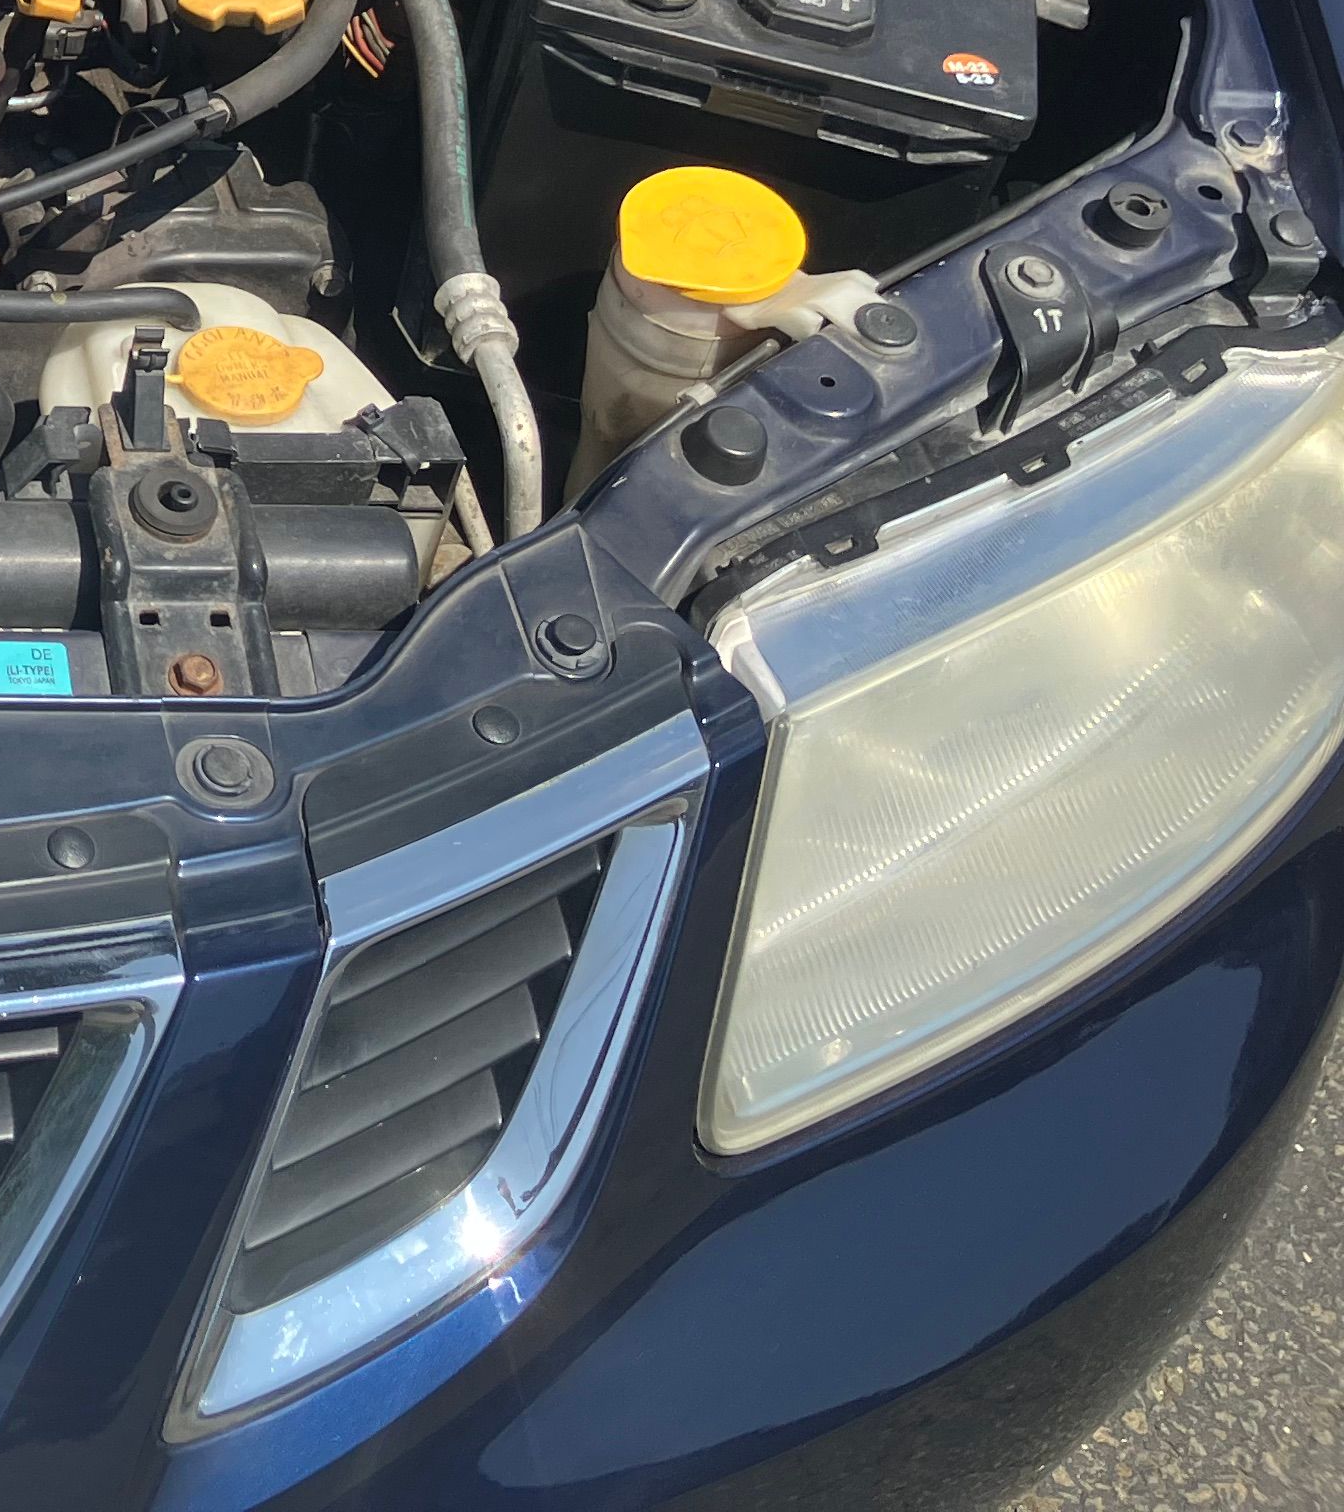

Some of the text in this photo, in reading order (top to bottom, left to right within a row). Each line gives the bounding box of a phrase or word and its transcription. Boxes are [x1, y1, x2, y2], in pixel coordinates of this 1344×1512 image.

[31, 648, 53, 661] DE
[6, 665, 54, 676] (LI-TYPE)
[8, 676, 32, 684] TOKYO
